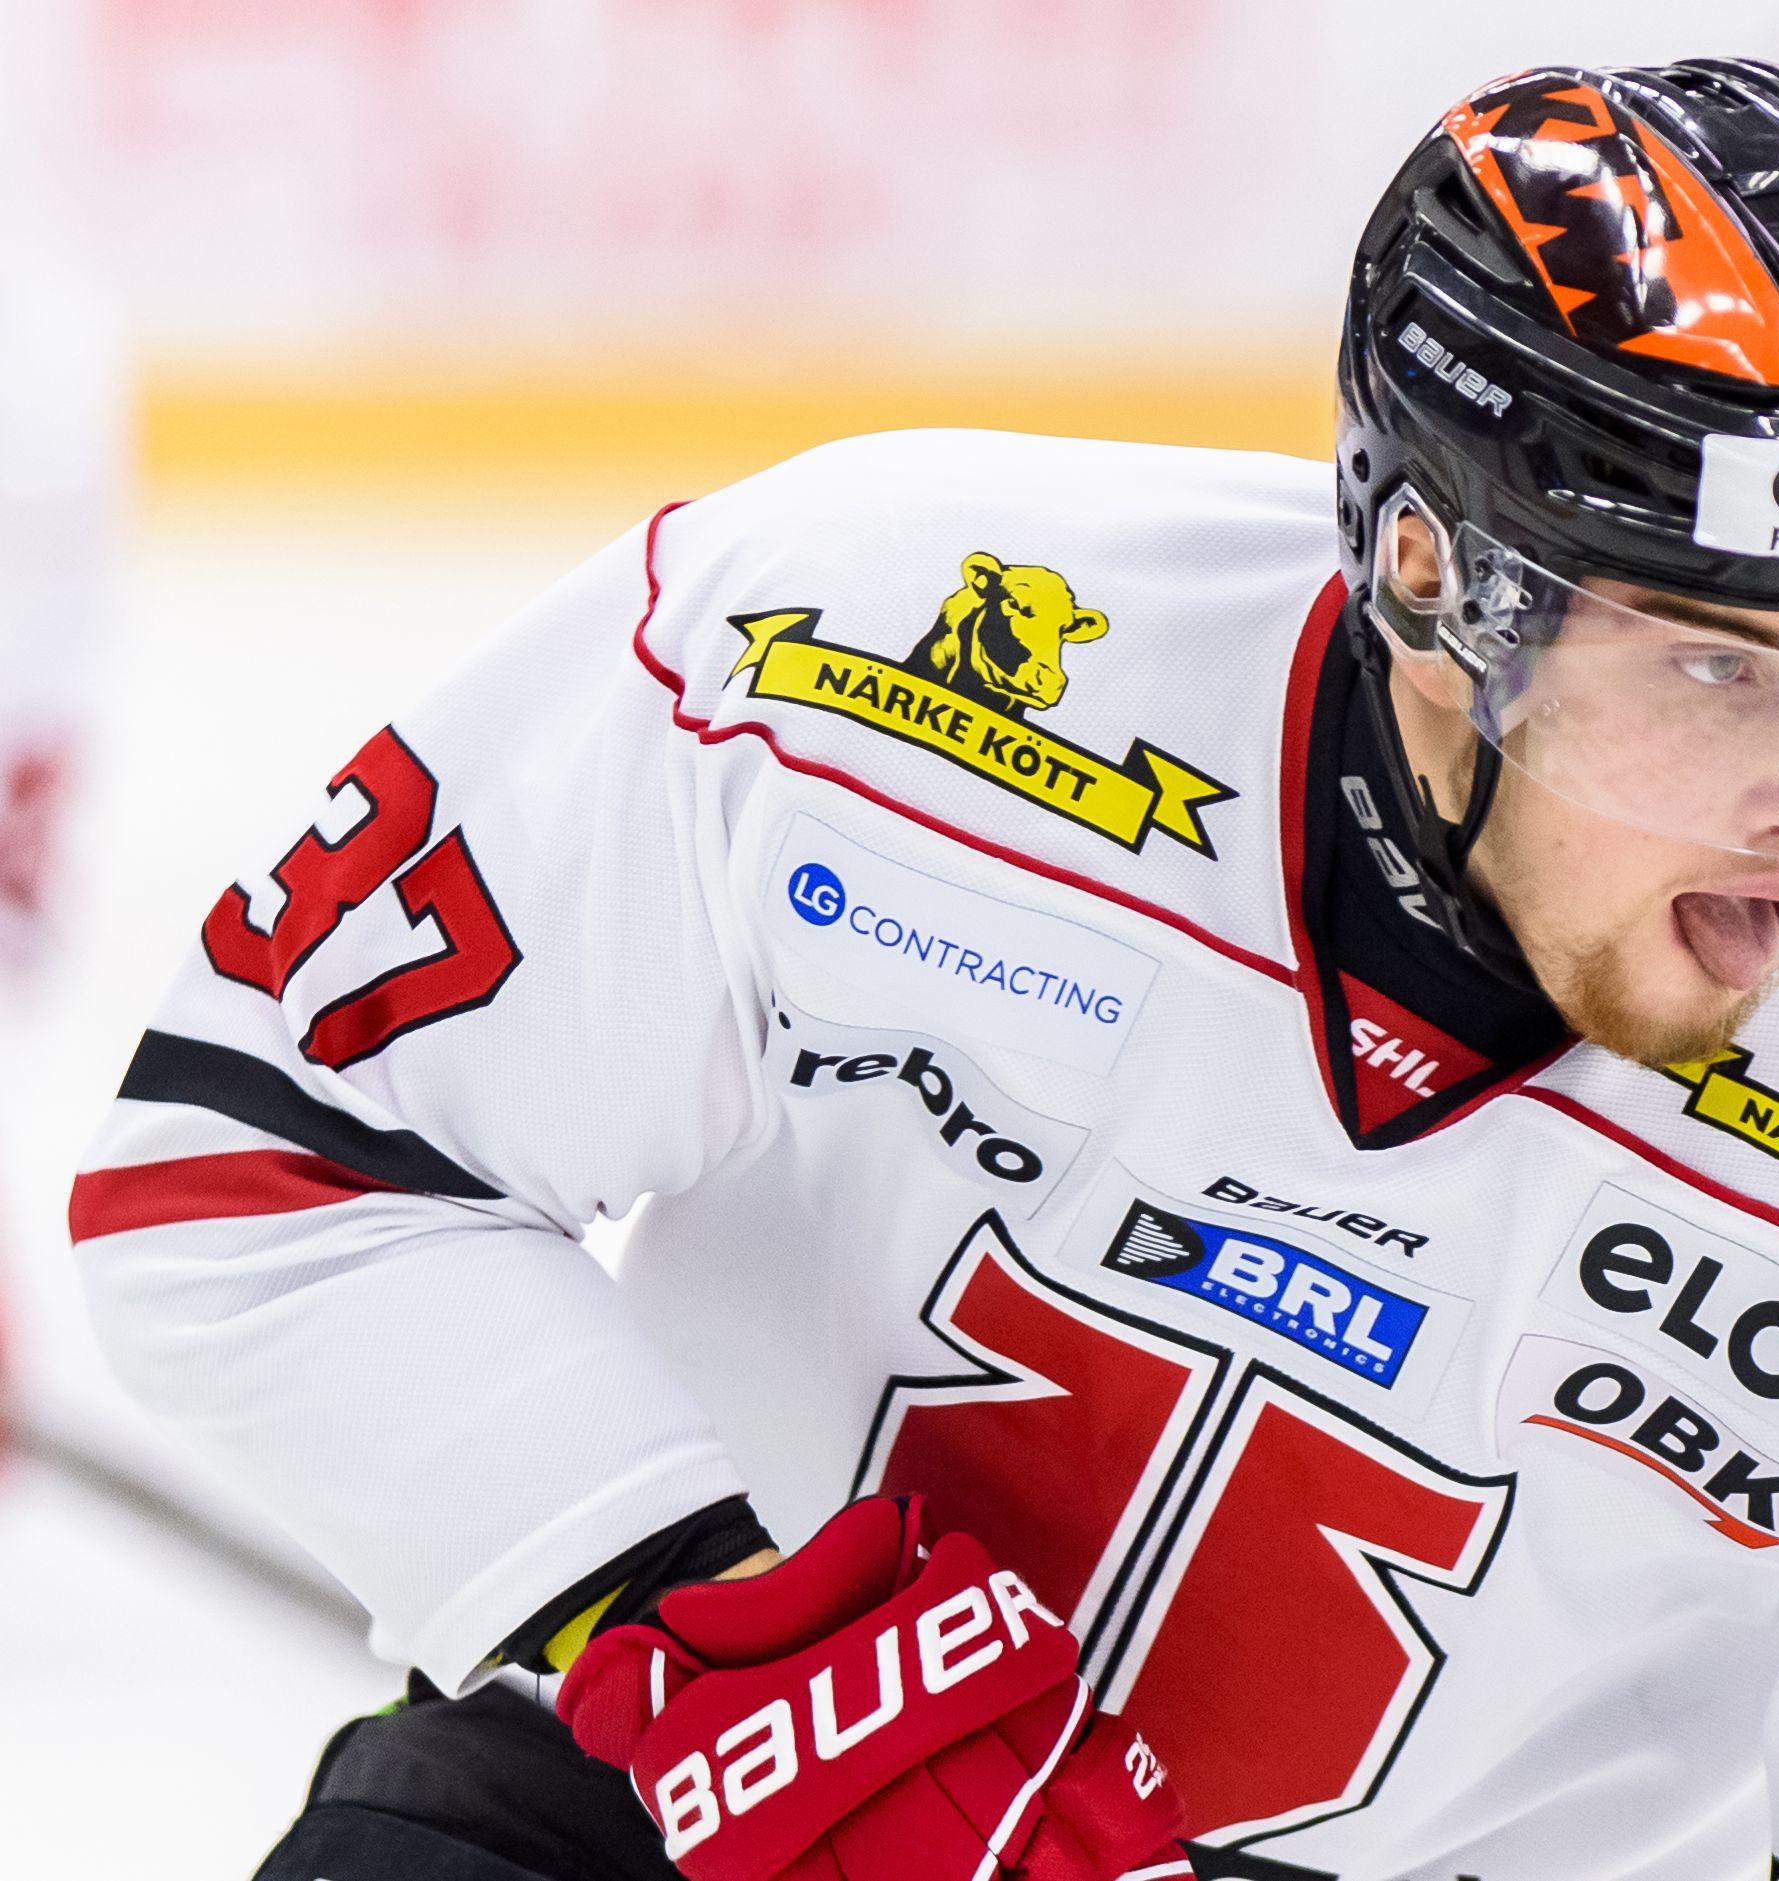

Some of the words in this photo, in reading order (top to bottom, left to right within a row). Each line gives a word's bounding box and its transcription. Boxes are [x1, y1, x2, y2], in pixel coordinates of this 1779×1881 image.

[813, 662, 975, 745] NÄRKE
[977, 727, 1098, 803] KÖTT
[201, 722, 525, 1074] 37
[793, 872, 841, 918] LG
[849, 905, 1124, 1025] CONTRACTING
[775, 1005, 1044, 1184] rebro
[1350, 1017, 1440, 1098] SHL
[1200, 1280, 1386, 1374] ELECTRONICS
[1206, 1237, 1394, 1362] BRL
